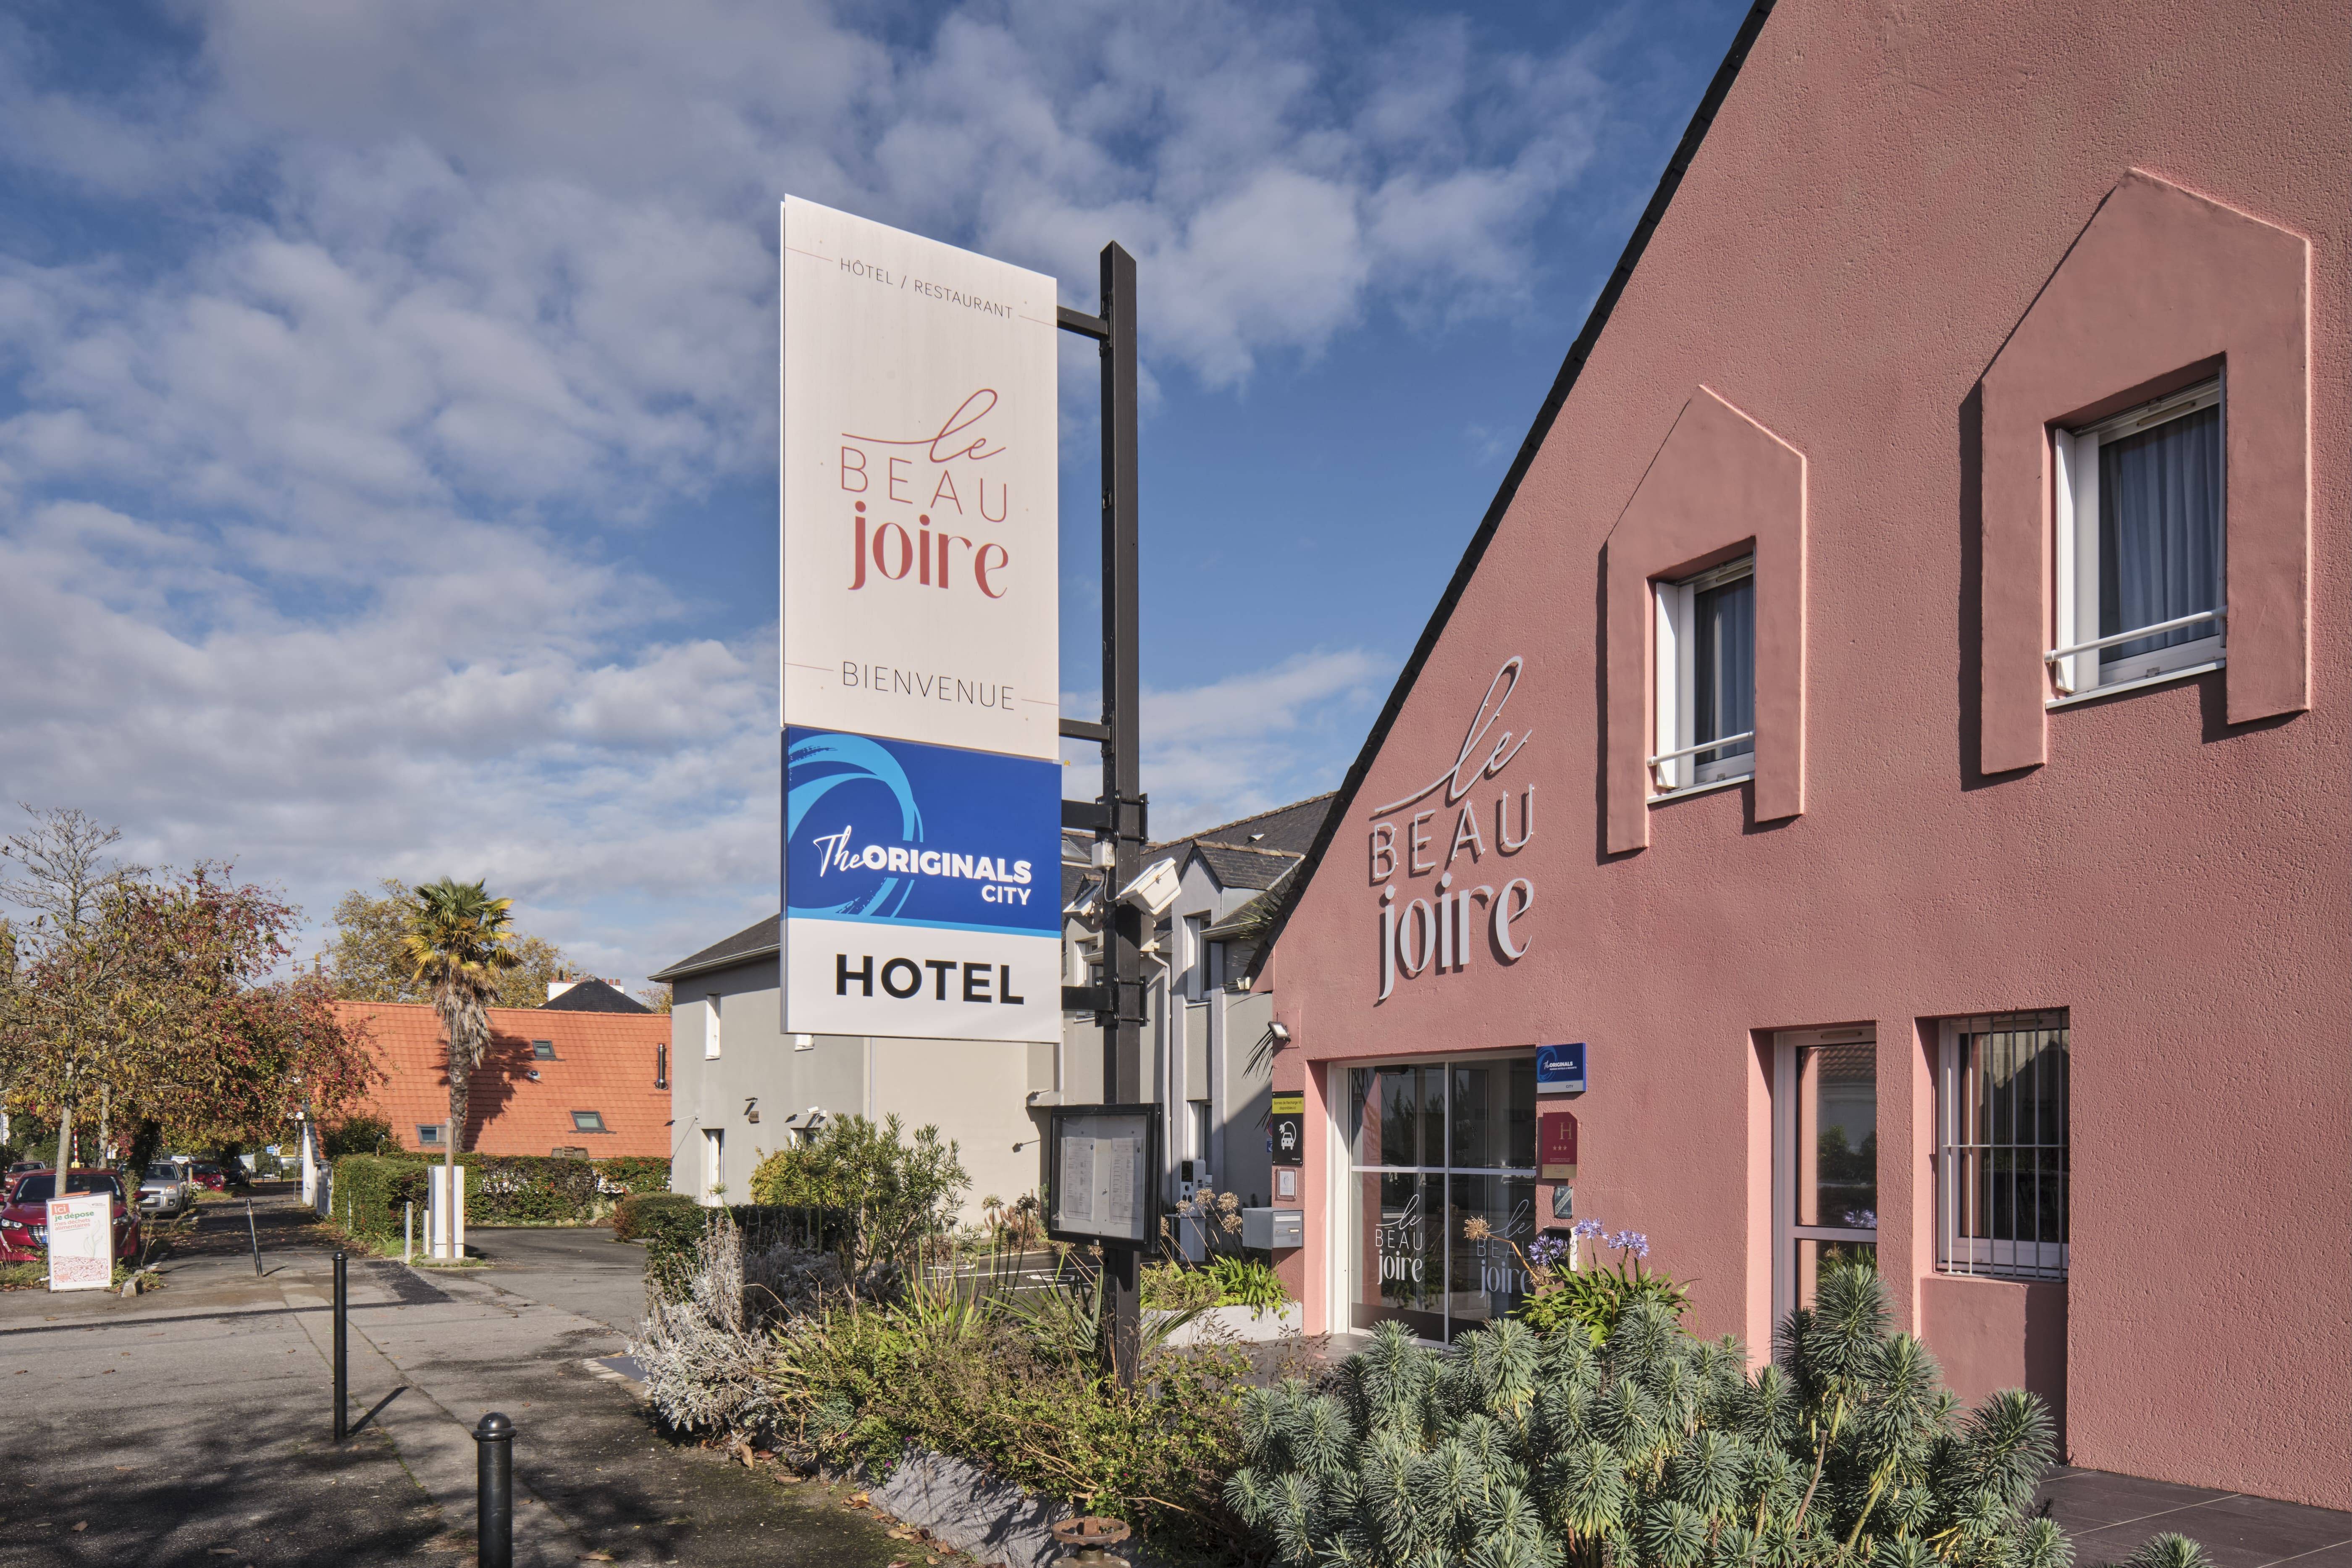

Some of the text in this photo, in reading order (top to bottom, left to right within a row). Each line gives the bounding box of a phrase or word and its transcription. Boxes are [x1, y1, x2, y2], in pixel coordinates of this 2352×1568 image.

[841, 257, 893, 285] HÔTEL
[914, 279, 1013, 320] RESTAURANT
[842, 388, 1007, 464] le
[841, 446, 1007, 523] BEAU
[848, 500, 1009, 599] joire
[843, 661, 1015, 711] BIENVENUE
[1374, 655, 1533, 813] le
[813, 825, 1032, 884] The ORIGINALS
[1374, 783, 1533, 879] BEAU
[981, 885, 1032, 906] CITY
[1379, 872, 1534, 1001] joire
[836, 954, 1024, 1005] HOTEL
[1559, 1122, 1573, 1140] H
[54, 1204, 66, 1213] Ici
[55, 1223, 91, 1231] alimentaires
[64, 1211, 94, 1219] dépose
[1376, 1194, 1422, 1230] le
[1489, 1199, 1532, 1238] le
[1376, 1229, 1422, 1250] BEAU
[1377, 1249, 1423, 1285] joire
